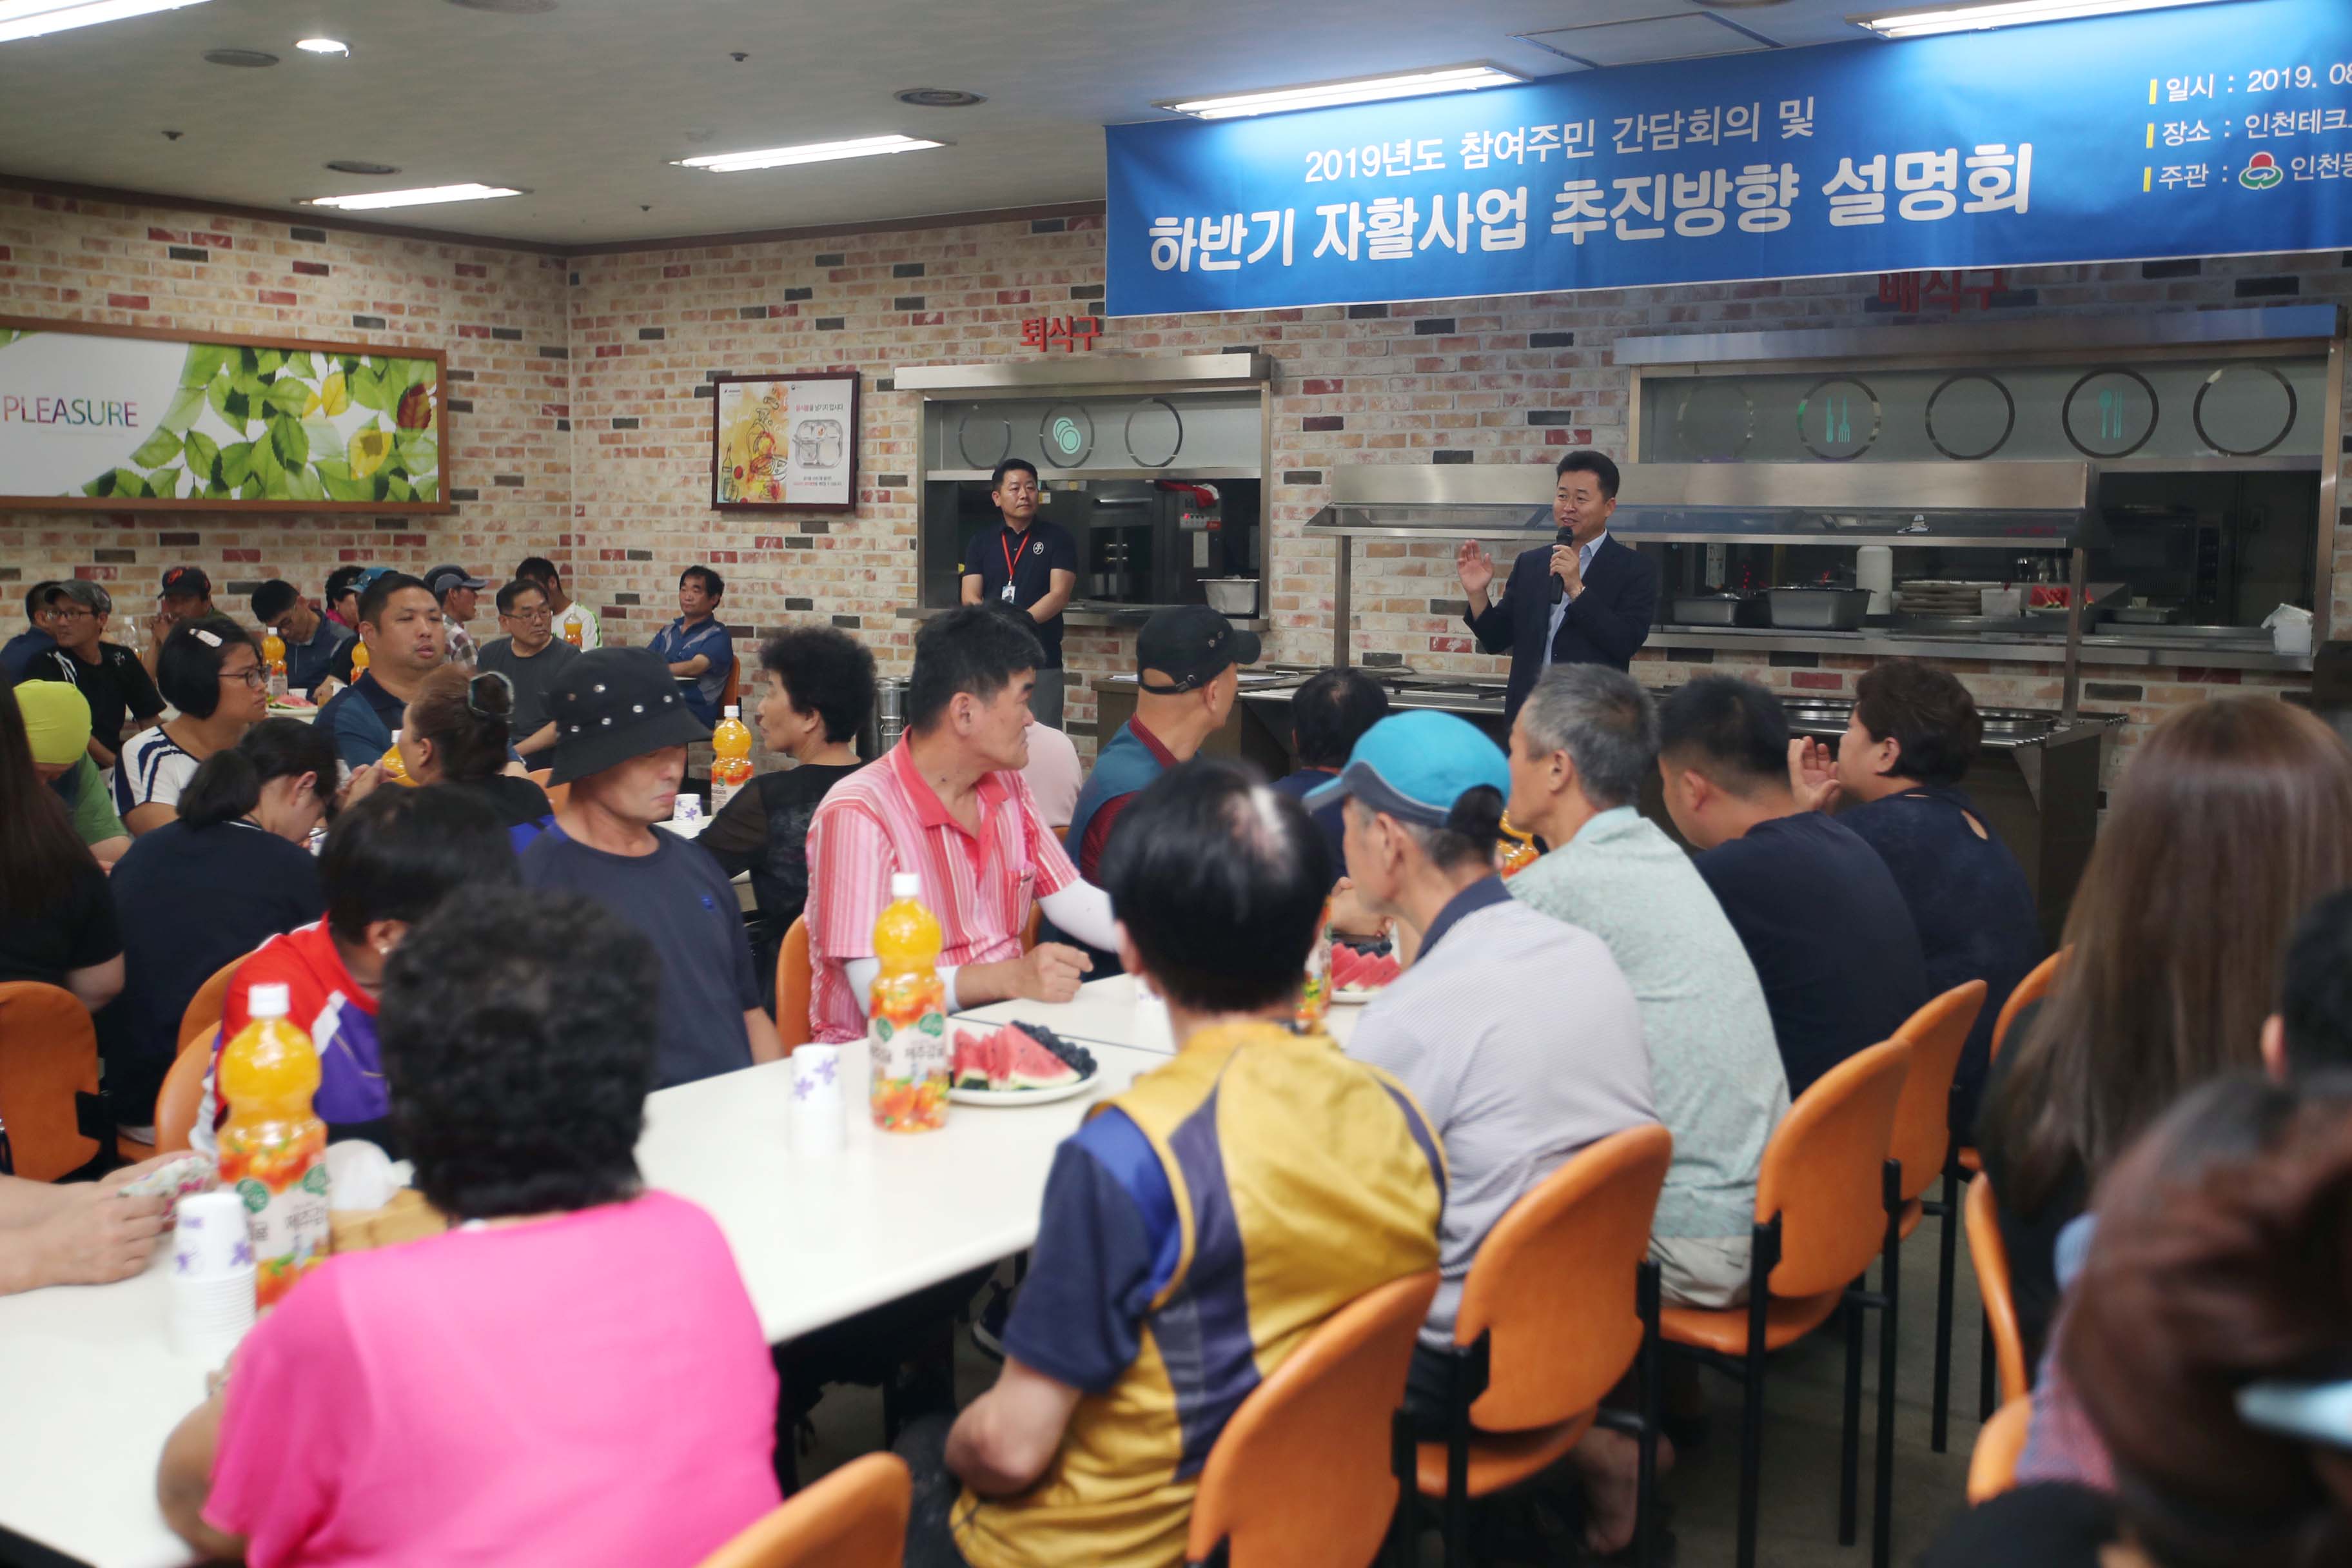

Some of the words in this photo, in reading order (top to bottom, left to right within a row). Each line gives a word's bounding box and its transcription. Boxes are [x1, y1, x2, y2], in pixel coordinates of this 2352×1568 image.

[2166, 74, 2215, 102] 일시
[2247, 66, 2317, 93] 2019.
[1306, 137, 1446, 182] 2019년도
[1460, 119, 1596, 170] 참여주민
[1612, 103, 1760, 154] 간담회의
[1779, 96, 1814, 139] 및
[2162, 120, 2211, 146] 장소
[2245, 109, 2352, 139] 인천테크
[2159, 163, 2209, 190] 주관
[1149, 208, 1295, 272] 하반기
[1313, 186, 1527, 261] 자활사업
[1551, 162, 1800, 246] 추진방향
[1822, 142, 2033, 227] 설명회
[1877, 269, 2008, 314] 배식구
[1020, 315, 1103, 353] 퇴식구
[3, 395, 139, 427] PLEASURE
